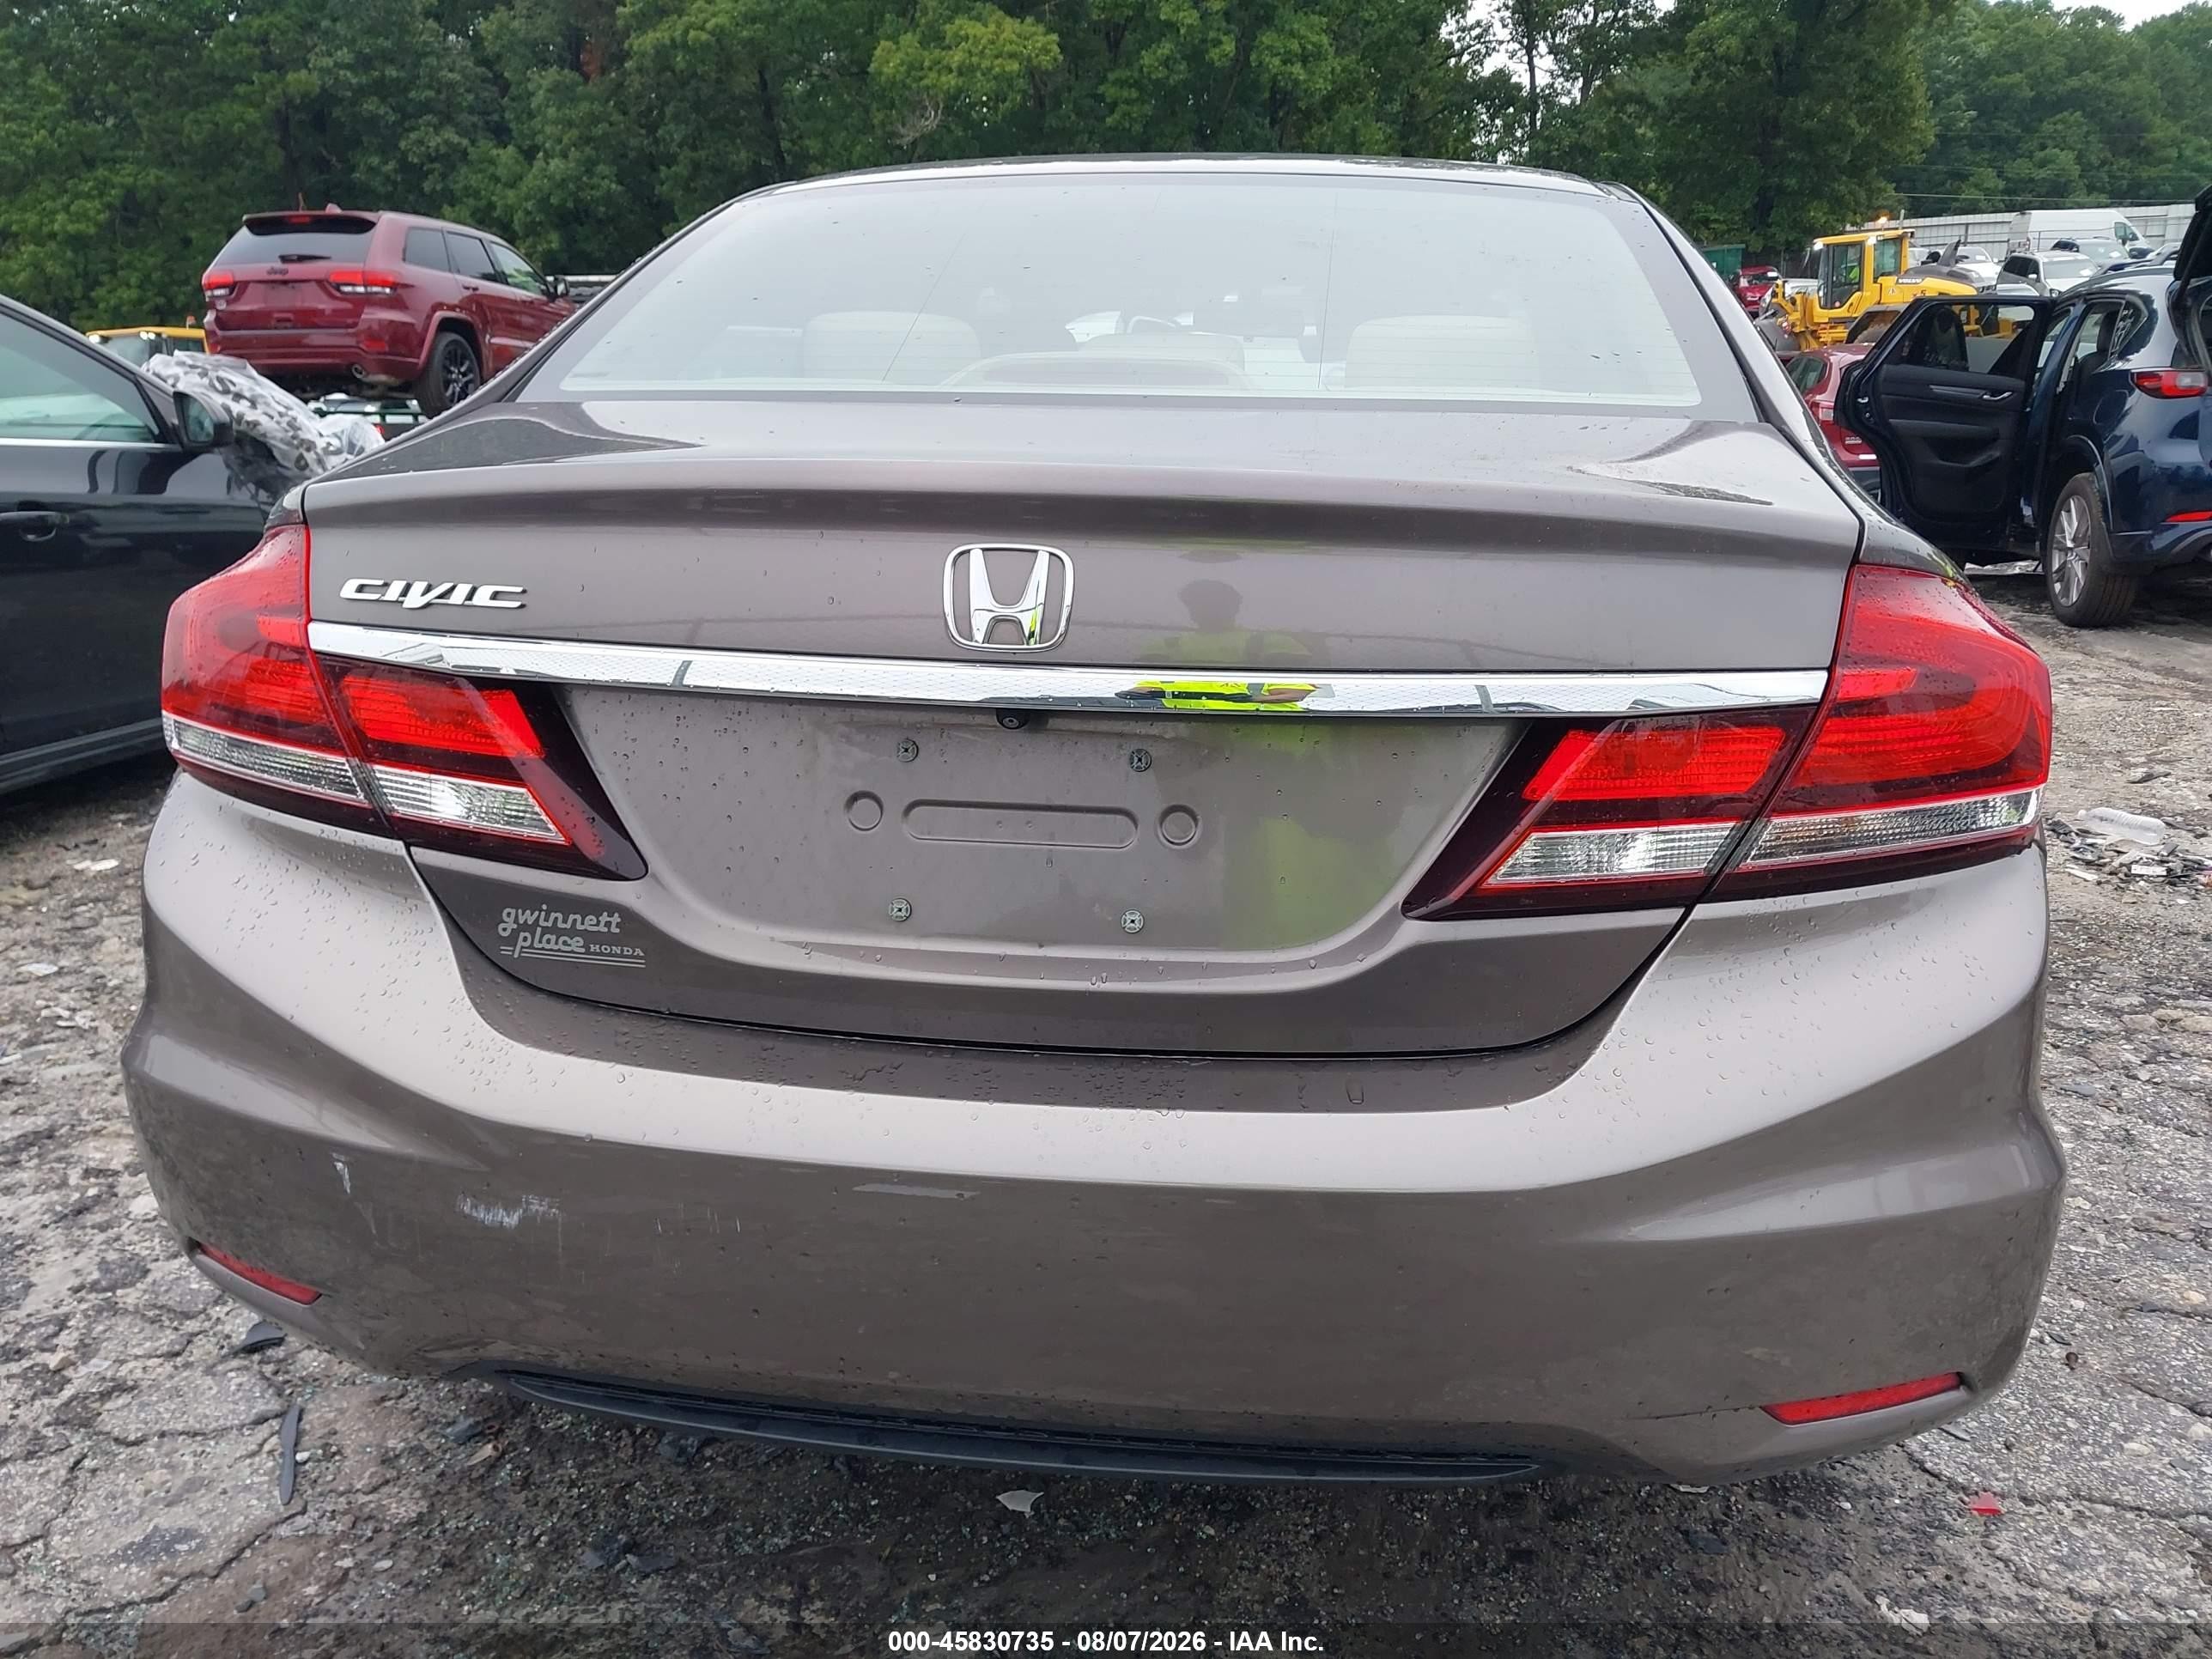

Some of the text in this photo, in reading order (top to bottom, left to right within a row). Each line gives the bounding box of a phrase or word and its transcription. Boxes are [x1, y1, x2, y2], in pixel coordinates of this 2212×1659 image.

[339, 578, 525, 609] CIVIC
[498, 904, 621, 937] gwinnett
[514, 927, 645, 957] place HONDA
